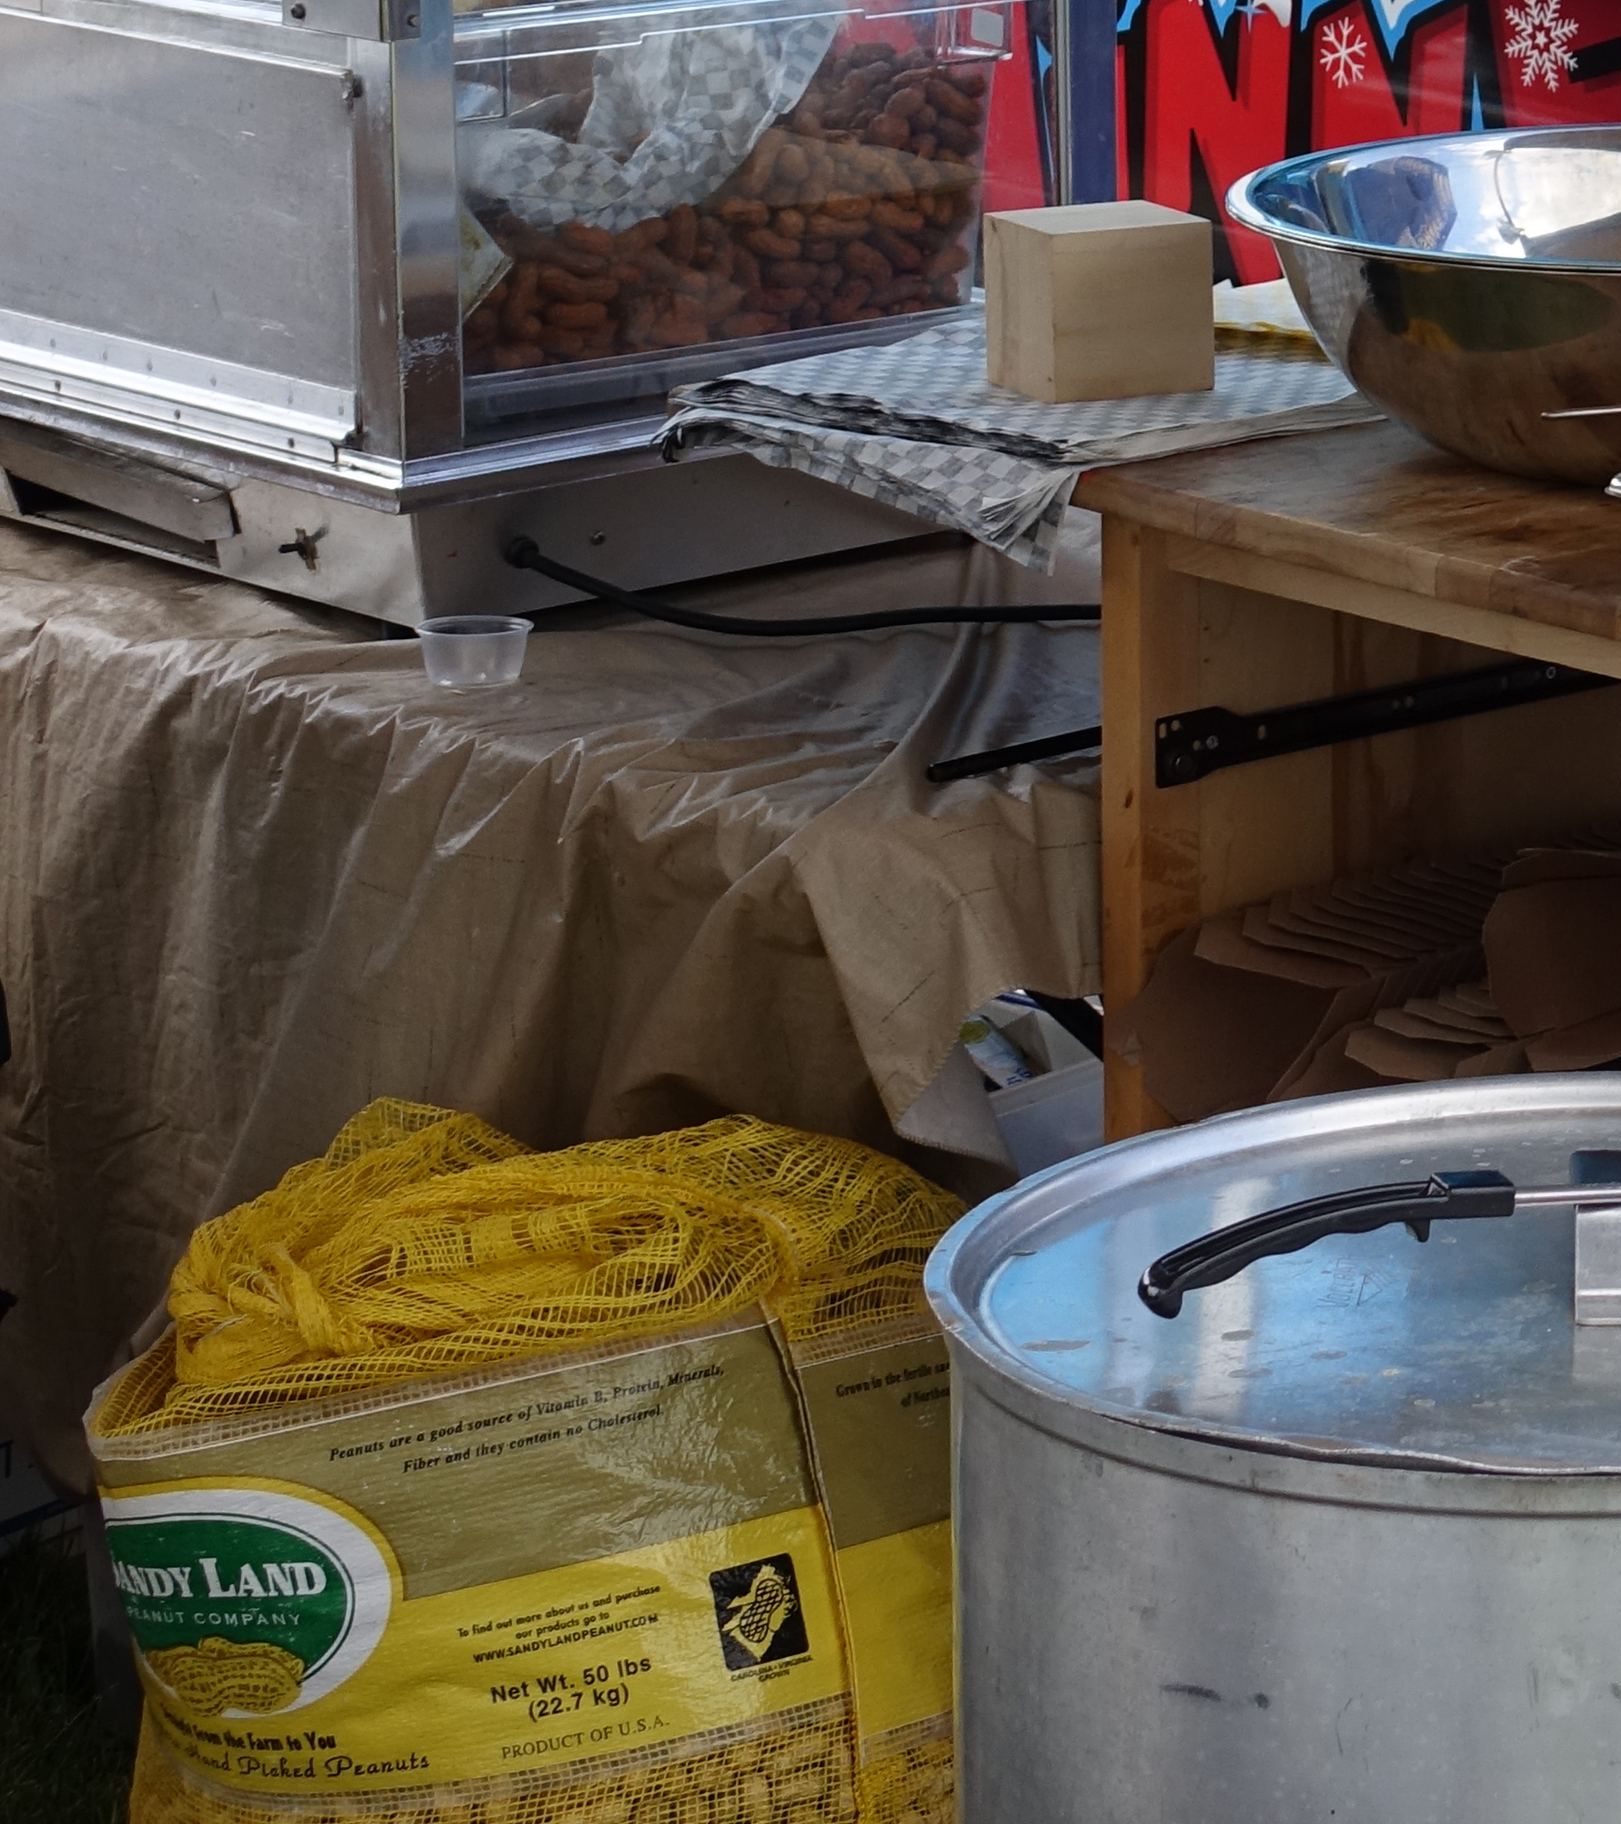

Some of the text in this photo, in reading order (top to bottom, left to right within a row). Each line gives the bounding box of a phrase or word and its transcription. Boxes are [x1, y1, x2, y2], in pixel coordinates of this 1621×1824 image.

[836, 1382, 871, 1398] Grown
[885, 1371, 901, 1386] the
[329, 1439, 385, 1462] Peanuts
[389, 1433, 412, 1448] are
[415, 1432, 425, 1443] a
[429, 1420, 464, 1444] good
[466, 1412, 514, 1433] source
[517, 1405, 534, 1423] of
[535, 1394, 590, 1416] Vitamin
[613, 1379, 664, 1400] Protein,
[666, 1363, 725, 1388] Minerals,
[402, 1456, 441, 1474] Fiber
[445, 1446, 471, 1465] and
[475, 1440, 504, 1457] they
[508, 1427, 562, 1451] contain
[565, 1424, 584, 1439] no
[199, 1557, 327, 1598] LAND
[126, 1605, 301, 1626] PEANUT COMPANY
[457, 1584, 661, 1639] To find out more about us and purchase
[515, 1610, 611, 1640] our products go to
[472, 1612, 659, 1664] WWW.SANDYLANDPEANUT.COM
[490, 1656, 653, 1704] Net Wt. 50 lbs
[528, 1681, 630, 1723] (22.7 kg)
[223, 1730, 246, 1750] the
[249, 1731, 284, 1752] Farm
[286, 1734, 303, 1751] to
[303, 1730, 337, 1750] You
[501, 1714, 671, 1760] PRODUCT OF U.S.A.
[238, 1755, 317, 1778] Picked
[324, 1750, 431, 1778] Peanuts
